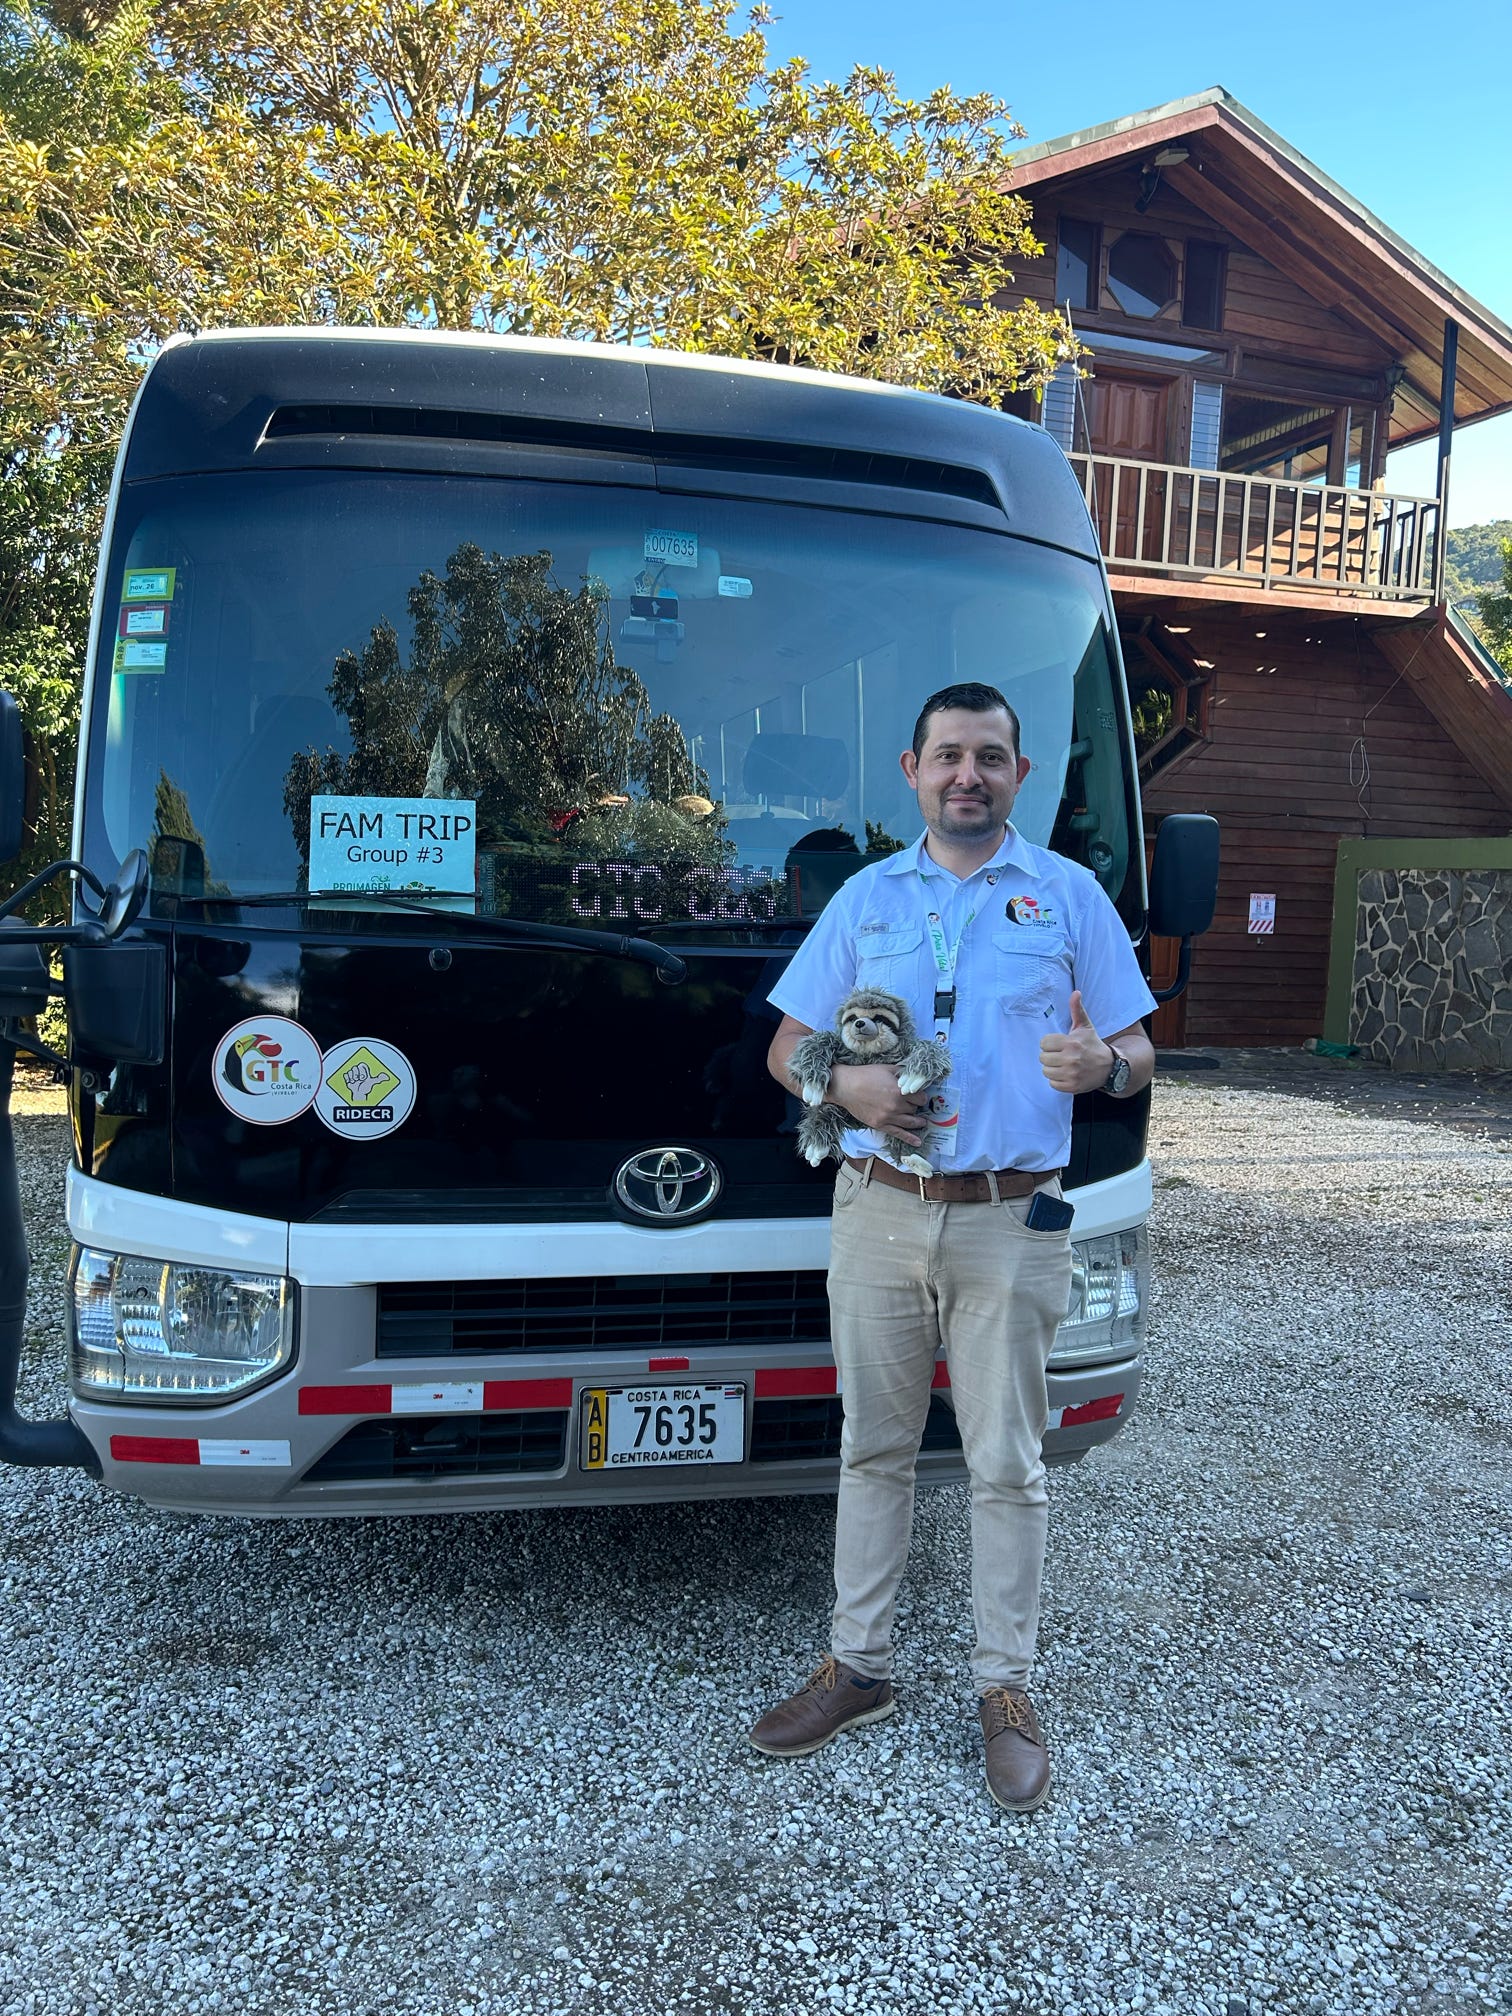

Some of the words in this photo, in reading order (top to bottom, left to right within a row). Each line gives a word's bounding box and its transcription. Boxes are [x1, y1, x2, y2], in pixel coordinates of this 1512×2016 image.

[651, 535, 695, 556] 007635
[319, 812, 383, 839] FAM
[395, 813, 472, 841] TRIP
[347, 845, 408, 866] Group
[416, 846, 444, 864] #3
[1017, 908, 1053, 920] GTC
[245, 1059, 300, 1083] GTC
[270, 1082, 293, 1090] Costa
[295, 1082, 312, 1090] Rica
[335, 1108, 391, 1120] RIDECR
[627, 1391, 667, 1402] COSTA
[673, 1389, 701, 1400] RICA
[633, 1403, 717, 1448] 7635
[611, 1448, 714, 1464] CENTROAMERICA
